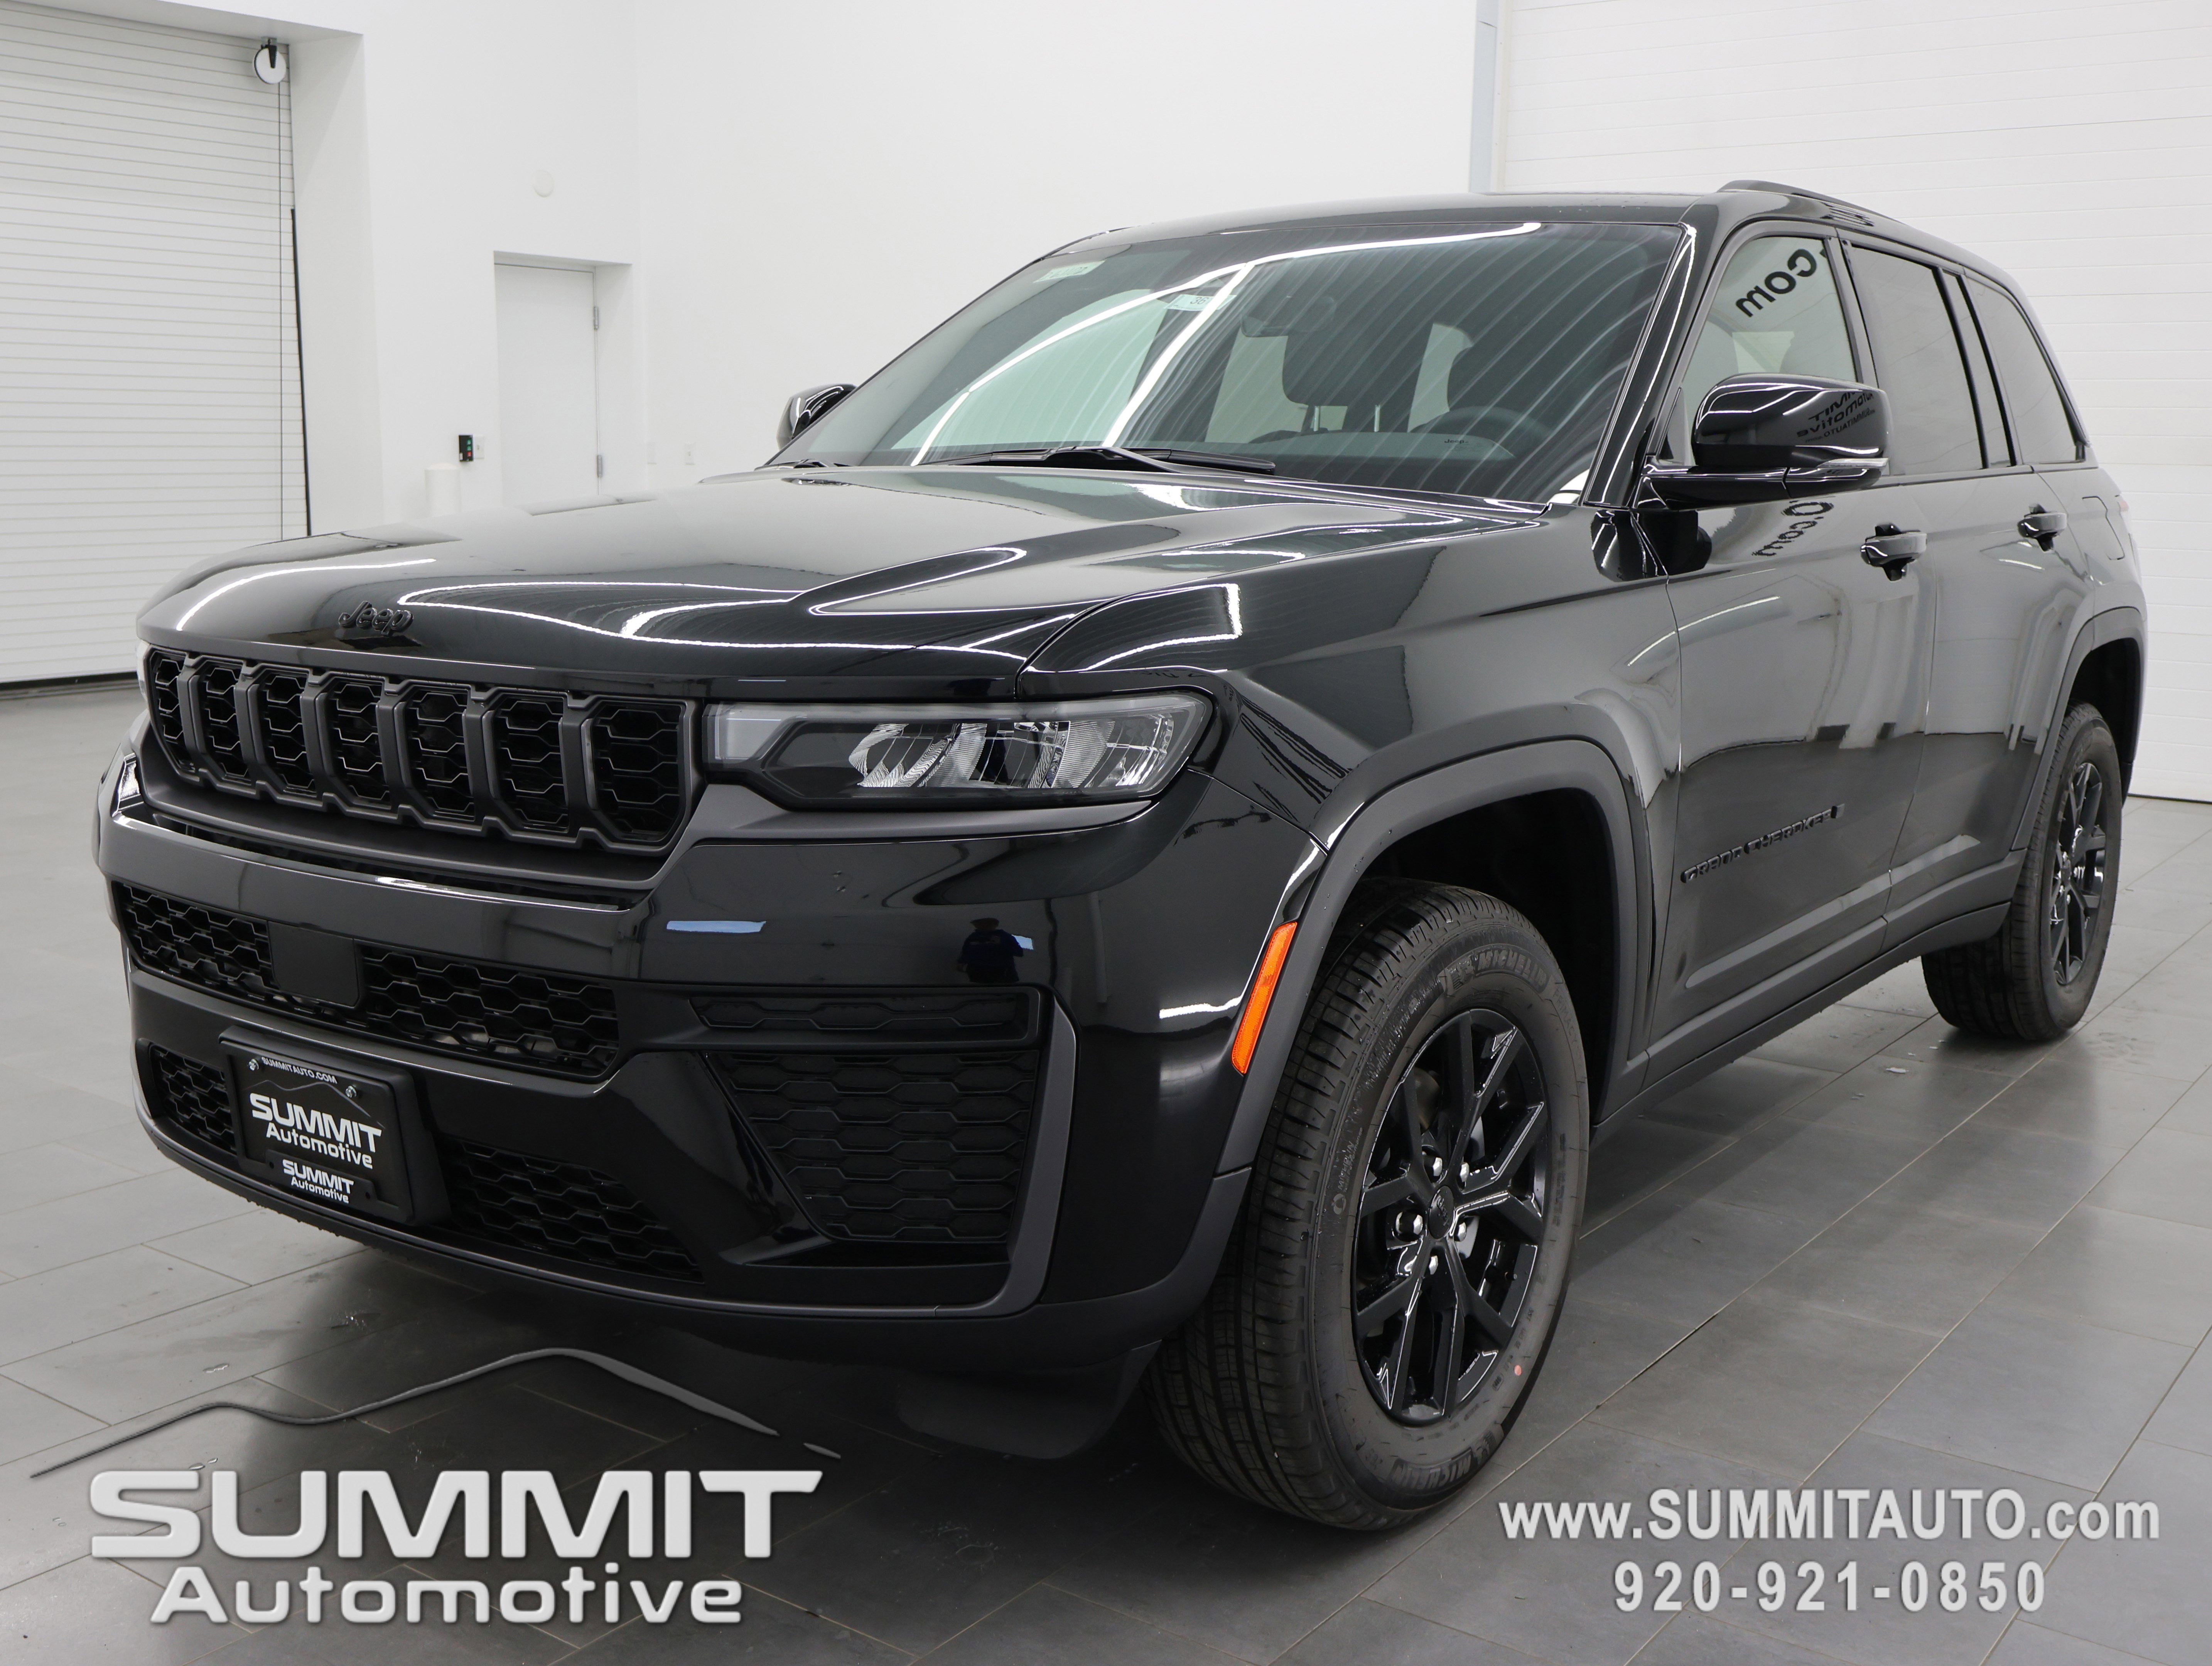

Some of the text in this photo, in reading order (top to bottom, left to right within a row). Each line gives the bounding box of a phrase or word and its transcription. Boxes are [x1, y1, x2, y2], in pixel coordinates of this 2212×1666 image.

[338, 600, 414, 635] Jeep
[1478, 948, 1548, 987] MICHELIN
[262, 1057, 337, 1084] SUMMITAUTO.COM
[250, 1093, 382, 1153] SUMMIT
[266, 1122, 373, 1169] Automotive
[282, 1159, 354, 1194] SUMMIT
[290, 1176, 349, 1204] Automotive
[1391, 1454, 1472, 1490] MICHELIN
